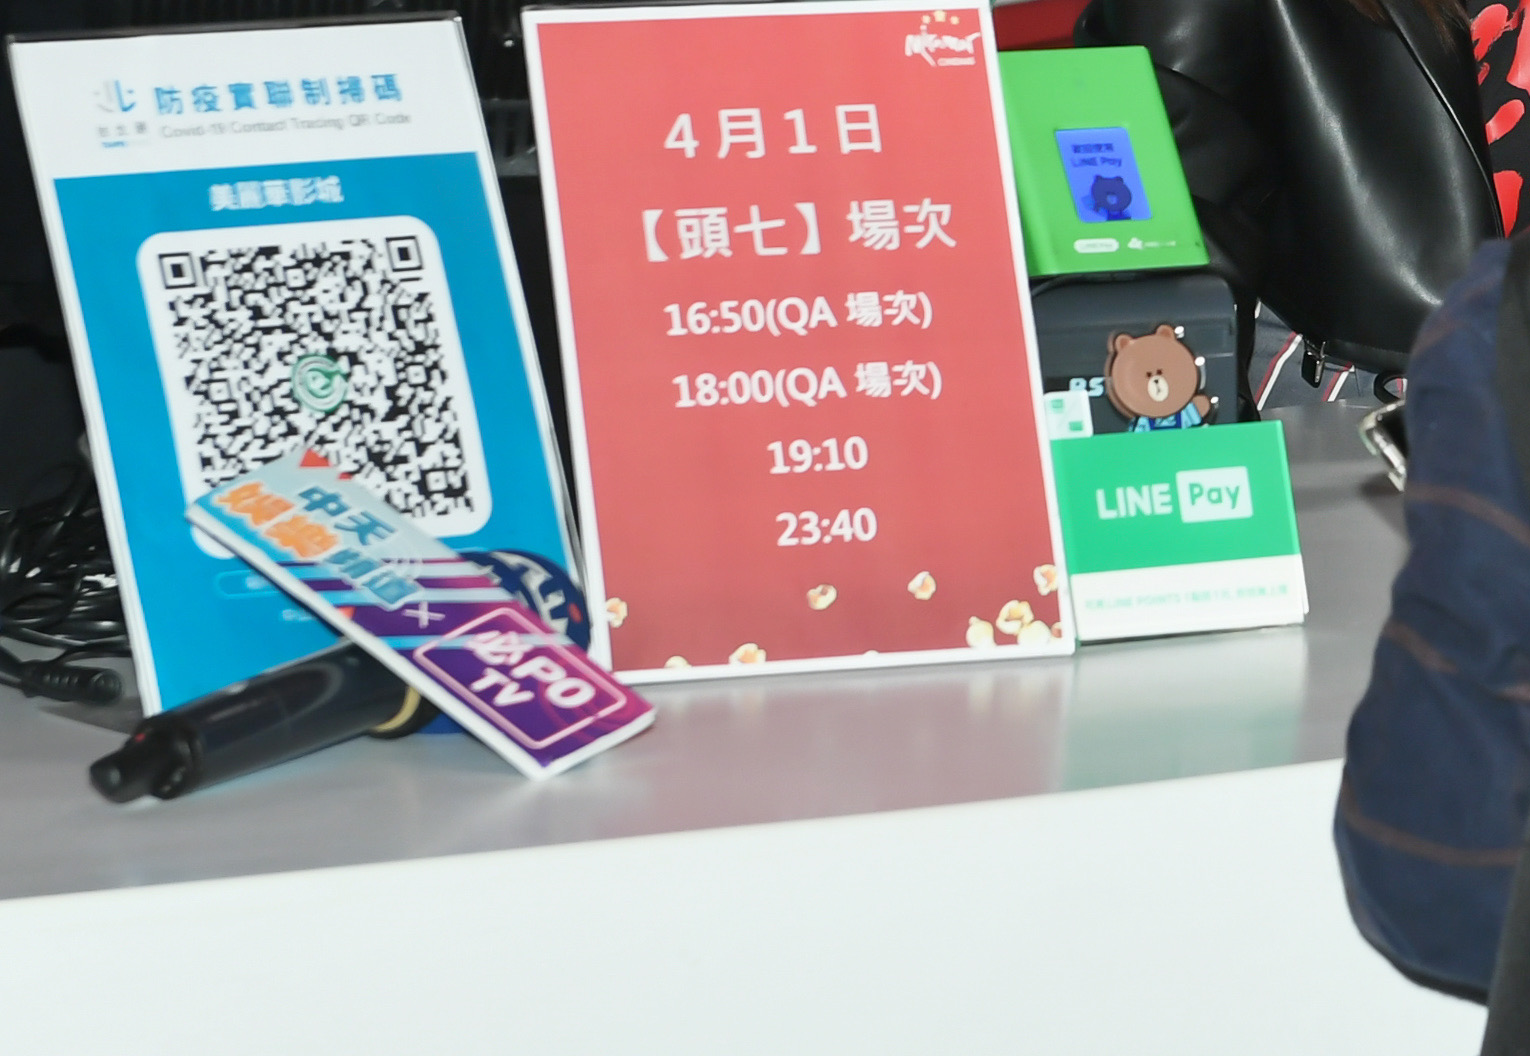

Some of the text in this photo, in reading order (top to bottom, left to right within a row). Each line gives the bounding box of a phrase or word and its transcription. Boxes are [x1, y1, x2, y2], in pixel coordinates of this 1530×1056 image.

[663, 290, 933, 337] 16:50(QA 場次)
[672, 360, 942, 408] 18:00(QA 場次)
[767, 435, 868, 474] 19:10
[298, 485, 397, 546] 中天
[1096, 480, 1242, 520] LINE Pay
[775, 507, 877, 546] 23:40
[469, 666, 536, 707] TV
